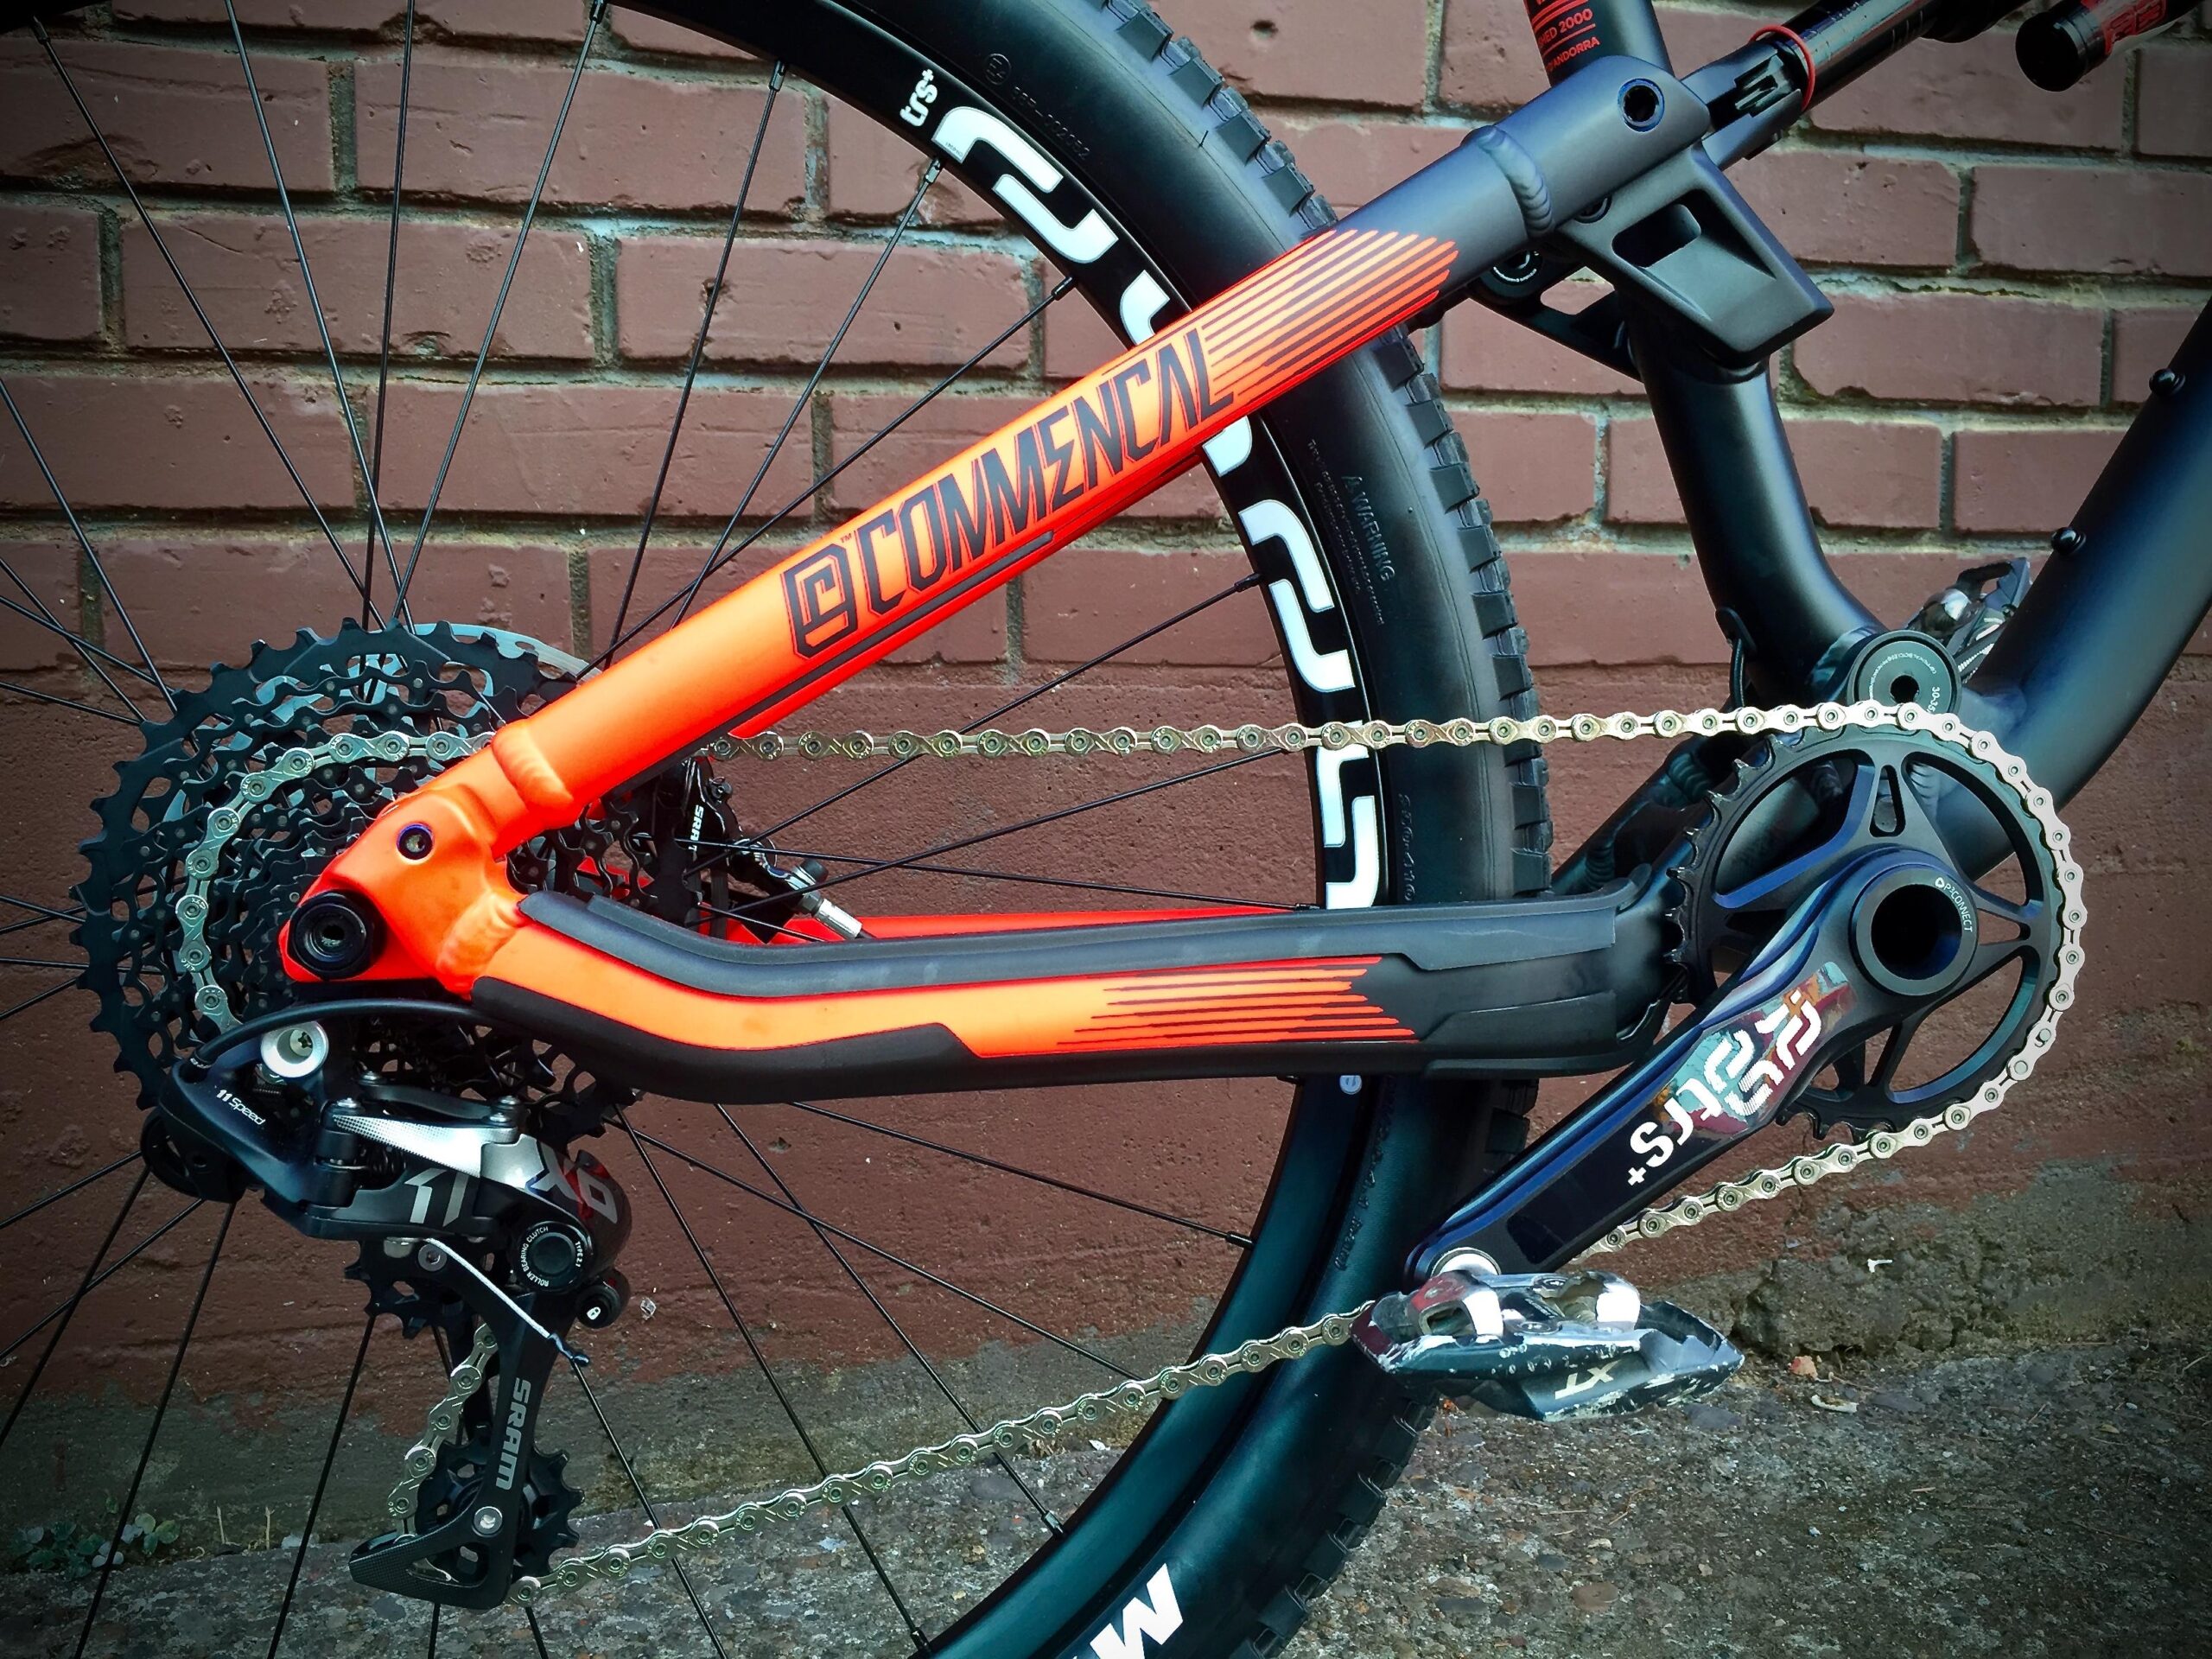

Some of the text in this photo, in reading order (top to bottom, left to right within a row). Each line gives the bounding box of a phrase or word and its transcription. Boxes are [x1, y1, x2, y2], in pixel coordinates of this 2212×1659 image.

[1559, 9, 1593, 33] 2000
[854, 327, 1234, 616] COMMENCAL
[1351, 491, 1395, 582] WARNING
[216, 1090, 266, 1125] 11 Speed
[520, 1226, 550, 1287] ROLLER BEARING CLUTCH
[495, 1376, 531, 1491] SRAM
